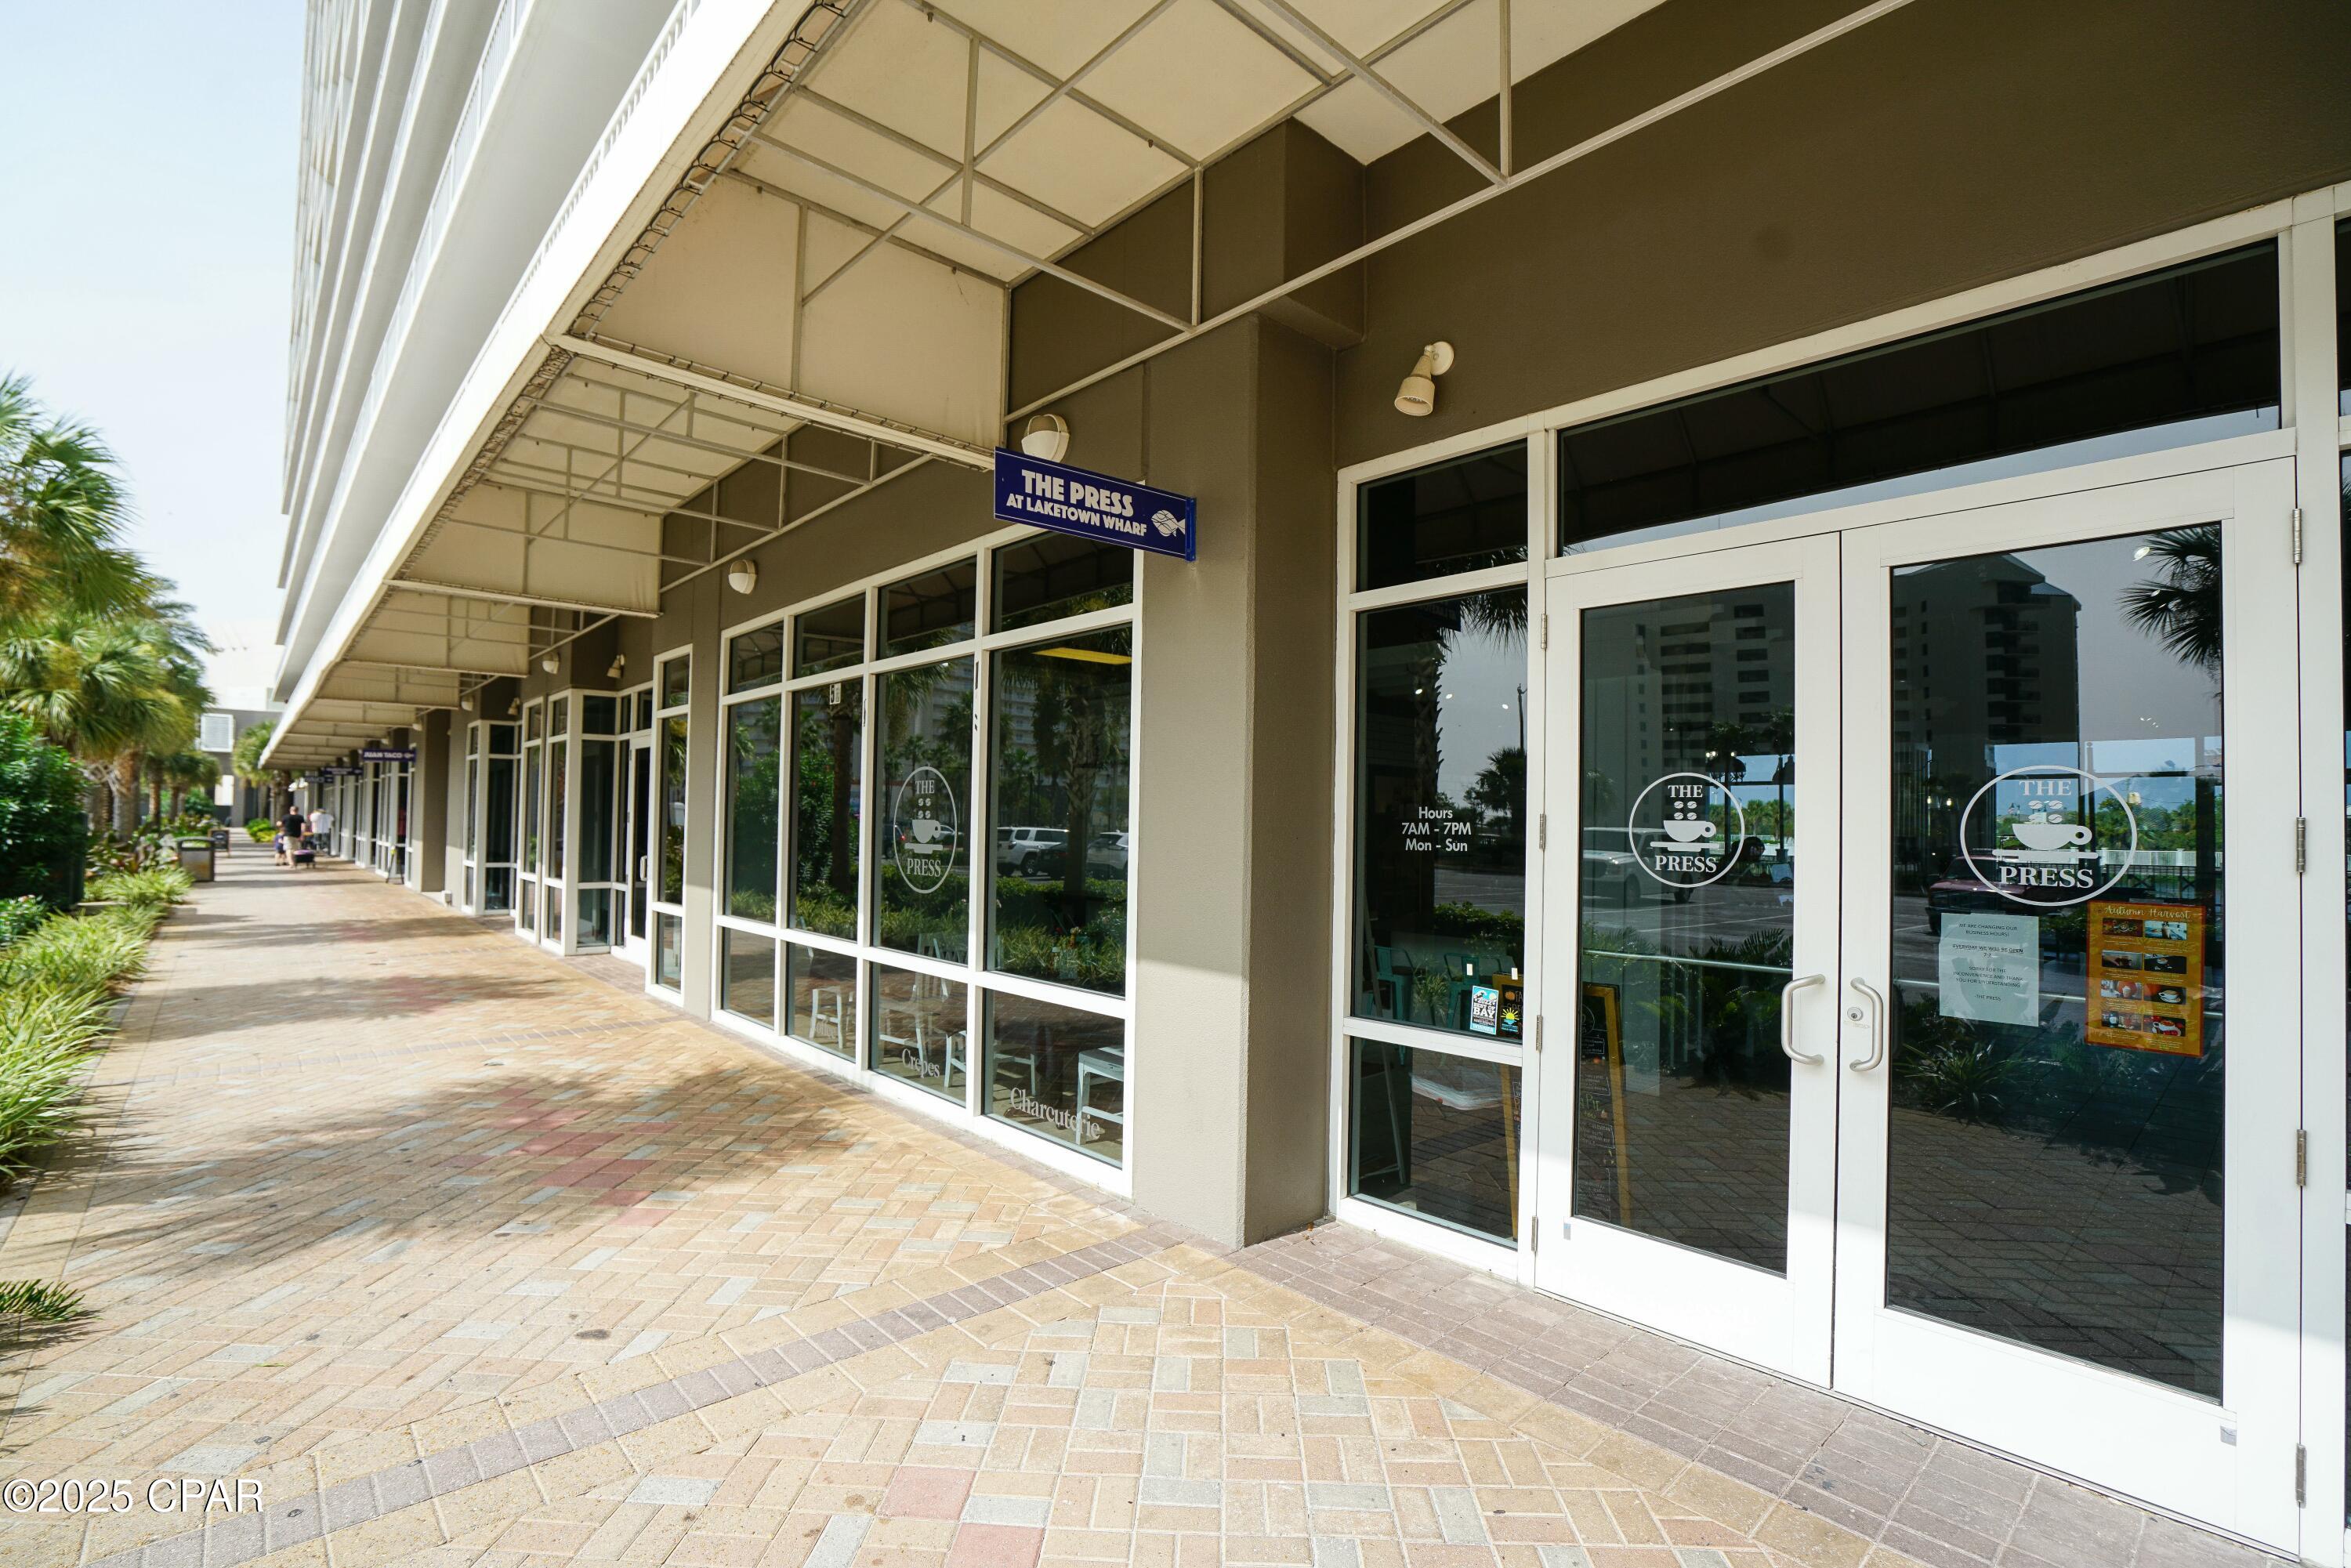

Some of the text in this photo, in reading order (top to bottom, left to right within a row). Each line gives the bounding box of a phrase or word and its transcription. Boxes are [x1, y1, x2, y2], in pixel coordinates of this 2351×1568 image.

[1022, 469, 1134, 517] THE PRESS
[1006, 493, 1147, 537] AT LAKETOWN WHARF
[915, 780, 935, 794] THE
[1668, 784, 1703, 798] THE
[2019, 780, 2072, 796] THE
[1418, 806, 1453, 819] Hours
[1401, 822, 1430, 835] 7AM
[1444, 822, 1472, 835] 7PM
[1405, 838, 1432, 851] Mon
[1445, 838, 1468, 852] Sun
[907, 858, 941, 877] PRESS
[1654, 855, 1717, 873] PRESS
[1998, 866, 2093, 889] PRESS
[2105, 905, 2191, 919] Autumn Harvest
[1978, 980, 2020, 988] UNDERSTANDING
[1473, 1007, 1495, 1019] BAY
[902, 1048, 940, 1078] Crepes
[1010, 1087, 1100, 1140] Charcuterie
